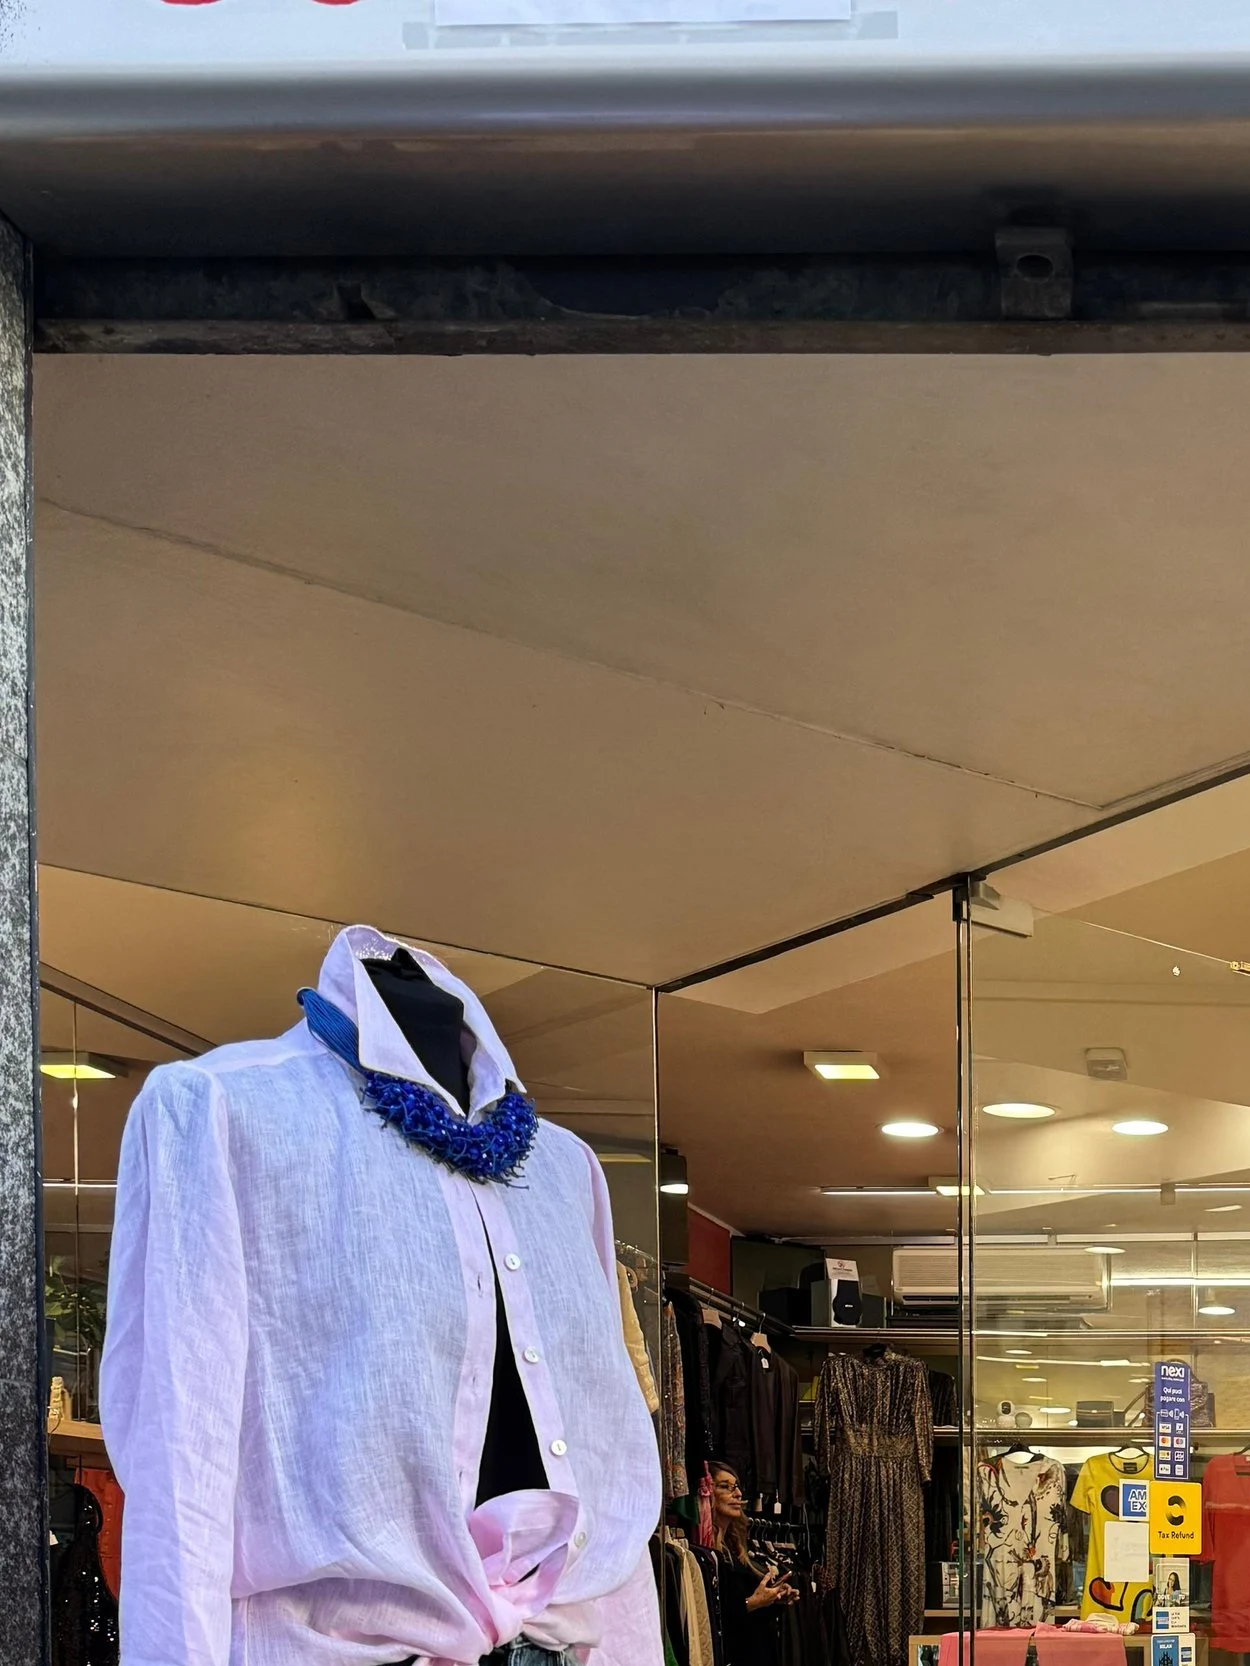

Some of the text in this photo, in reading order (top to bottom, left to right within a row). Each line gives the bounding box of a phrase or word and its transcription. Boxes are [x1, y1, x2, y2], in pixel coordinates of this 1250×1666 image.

[1160, 1365, 1185, 1378] nexi
[1158, 1530, 1194, 1539] Tax Refund
